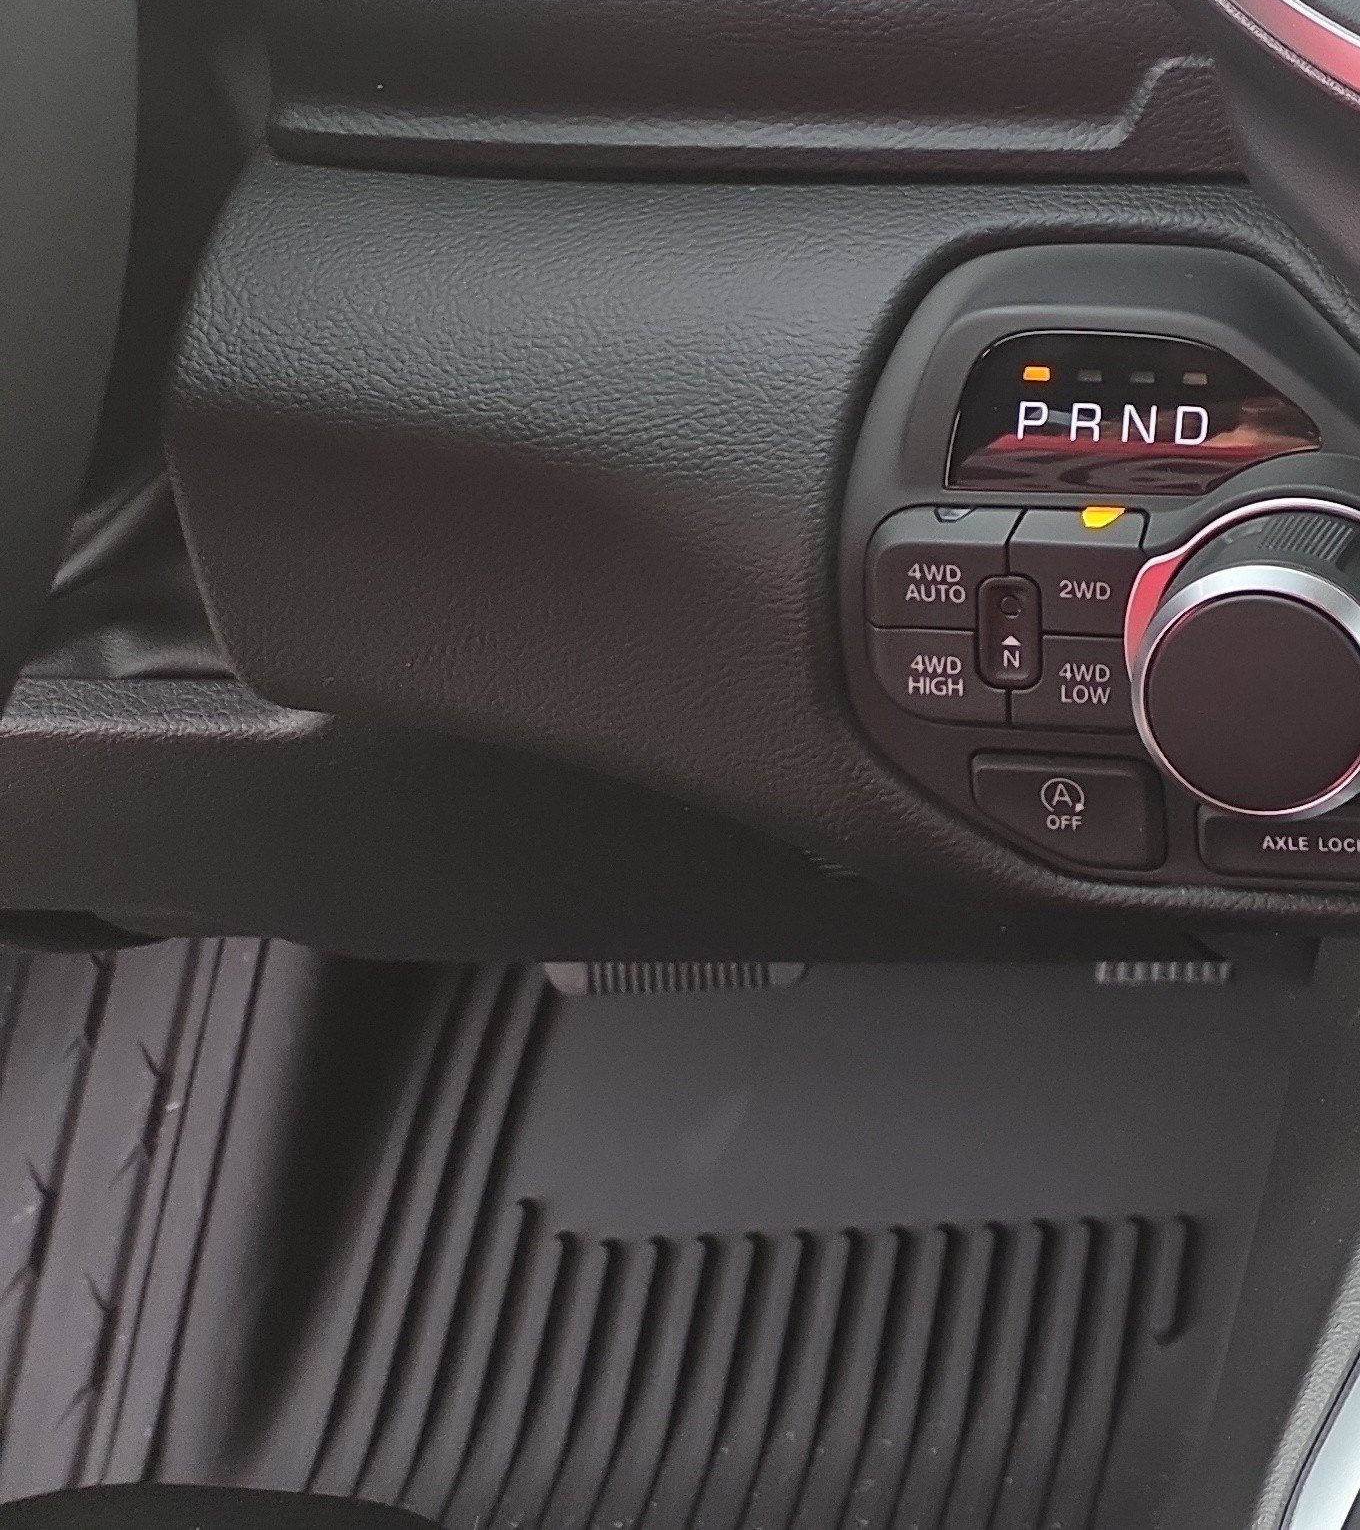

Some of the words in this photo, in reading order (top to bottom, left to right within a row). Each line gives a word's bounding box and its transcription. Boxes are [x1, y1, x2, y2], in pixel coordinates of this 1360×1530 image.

[1016, 401, 1050, 440] P
[1069, 404, 1101, 442] R
[1121, 405, 1157, 444] N
[1174, 406, 1209, 446] D
[908, 563, 961, 584] 4WD
[905, 582, 967, 604] AUTO
[1058, 580, 1111, 600] 2WD
[910, 655, 962, 676] 4WD
[1003, 649, 1020, 668] N
[1058, 663, 1111, 684] 4WD
[908, 676, 964, 698] HIGH
[1060, 683, 1111, 705] LOW
[1046, 814, 1082, 831] OFF
[1261, 836, 1309, 852] AXLE
